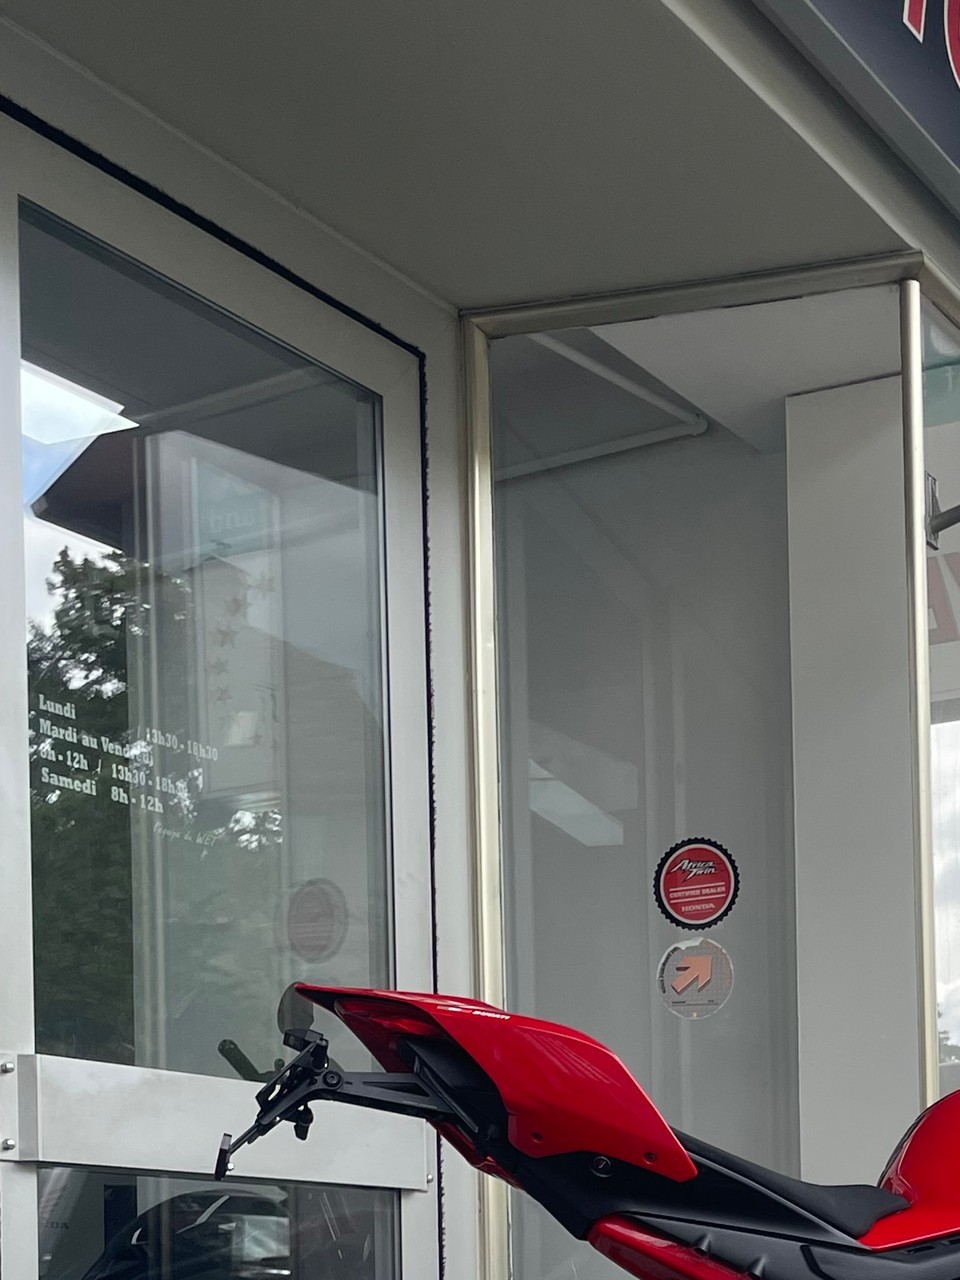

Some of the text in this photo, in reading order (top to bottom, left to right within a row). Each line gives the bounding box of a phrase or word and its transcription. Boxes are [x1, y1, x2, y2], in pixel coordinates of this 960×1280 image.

[39, 693, 77, 719] Lundi
[39, 718, 78, 743] Mardi
[81, 734, 98, 749] au
[66, 750, 89, 771] 12h
[111, 763, 147, 787] 13h30
[41, 767, 97, 796] Samedi
[110, 786, 129, 805] 8h
[140, 794, 164, 814] 12h
[670, 859, 716, 873] Africa
[685, 868, 716, 881] Twin
